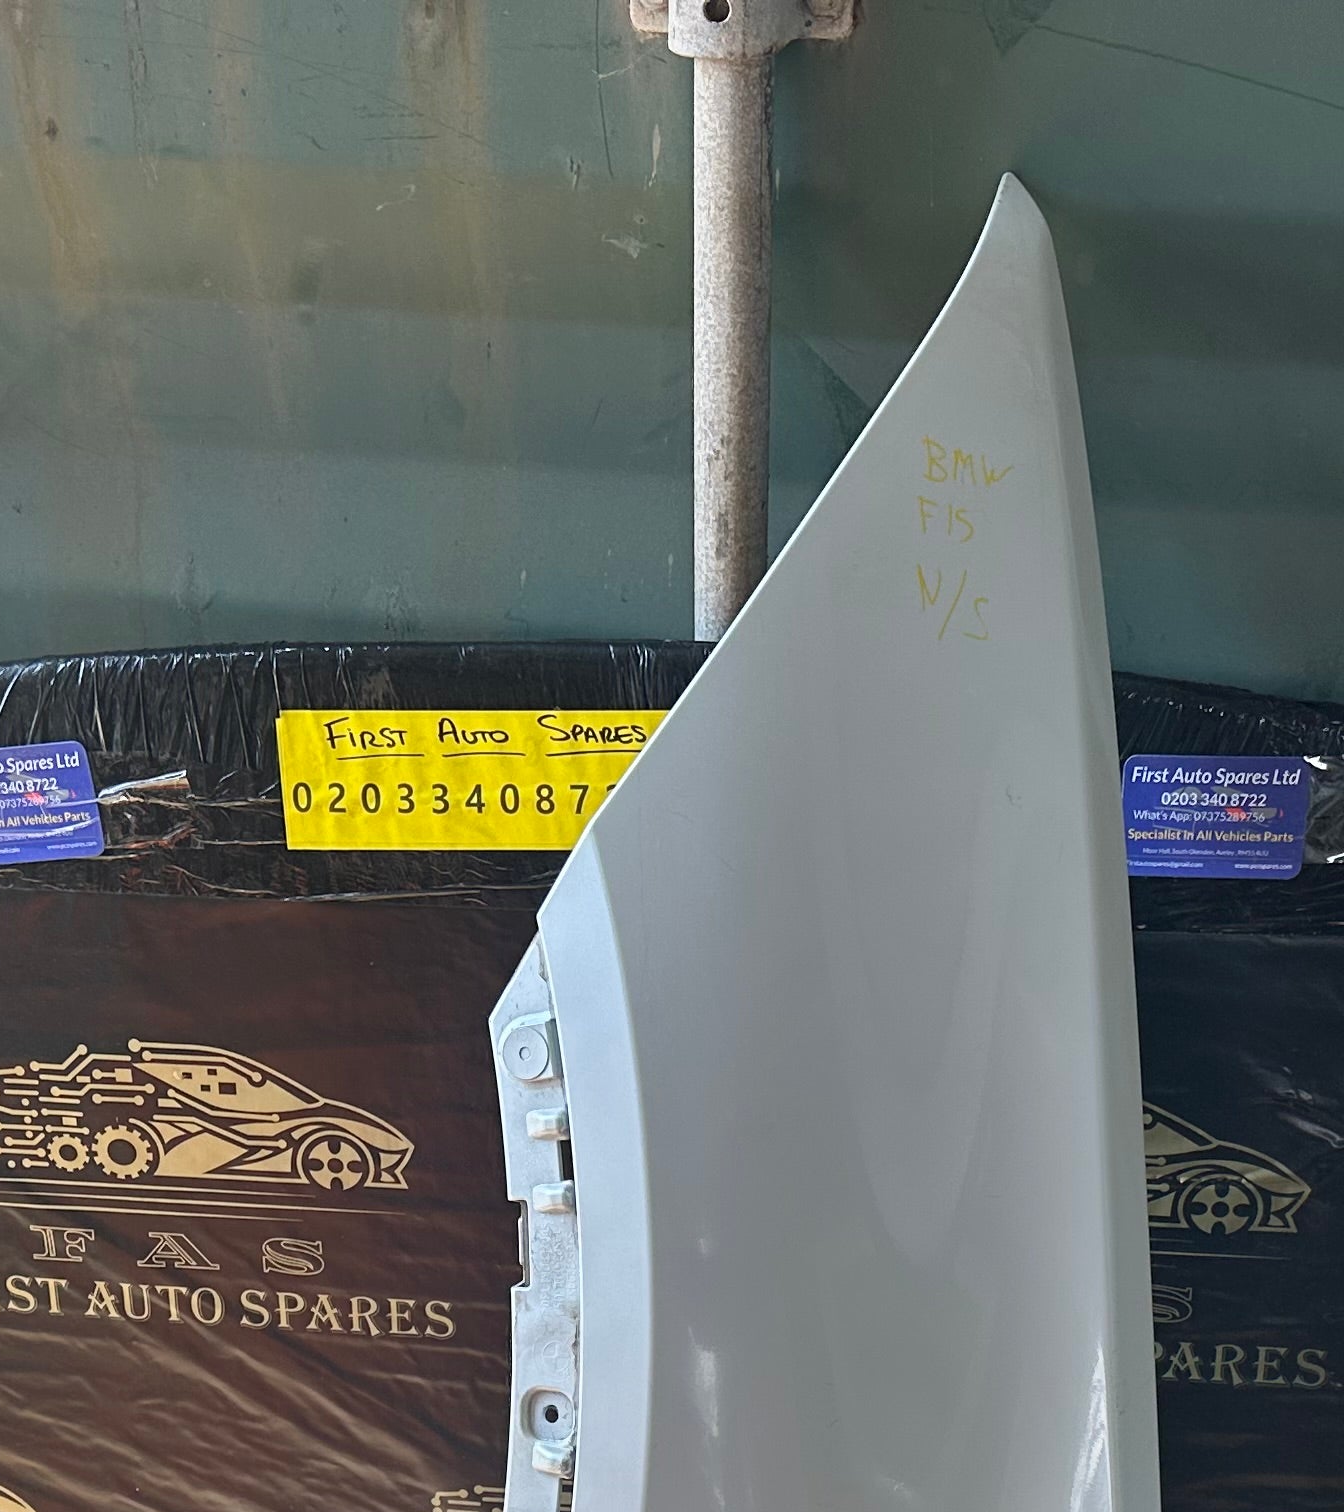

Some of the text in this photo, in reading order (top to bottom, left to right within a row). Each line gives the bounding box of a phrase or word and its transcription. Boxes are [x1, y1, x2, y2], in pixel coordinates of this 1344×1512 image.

[922, 434, 1014, 486] BMW
[917, 495, 975, 543] F15
[916, 563, 991, 640] N/S
[438, 717, 510, 744] AUTO
[537, 714, 648, 744] SPARES
[6, 756, 54, 775] Spares
[55, 751, 80, 769] Ltd
[0, 781, 25, 795] 340
[26, 777, 58, 792] 8722
[1131, 766, 1302, 787] First Auto Spares Ltd
[292, 782, 616, 814] 020334087
[1161, 792, 1267, 807] 0203 340 8722
[7, 815, 20, 827] All
[22, 812, 64, 826] Vehicles
[64, 810, 91, 823] Parts
[1133, 809, 1168, 821] What's
[1127, 828, 1181, 841] Specialist
[1196, 829, 1212, 841] All
[1215, 830, 1261, 842] Vehicles
[1263, 831, 1294, 843] Parts
[84, 1280, 226, 1327] AUTO
[240, 1288, 456, 1340] SPARES
